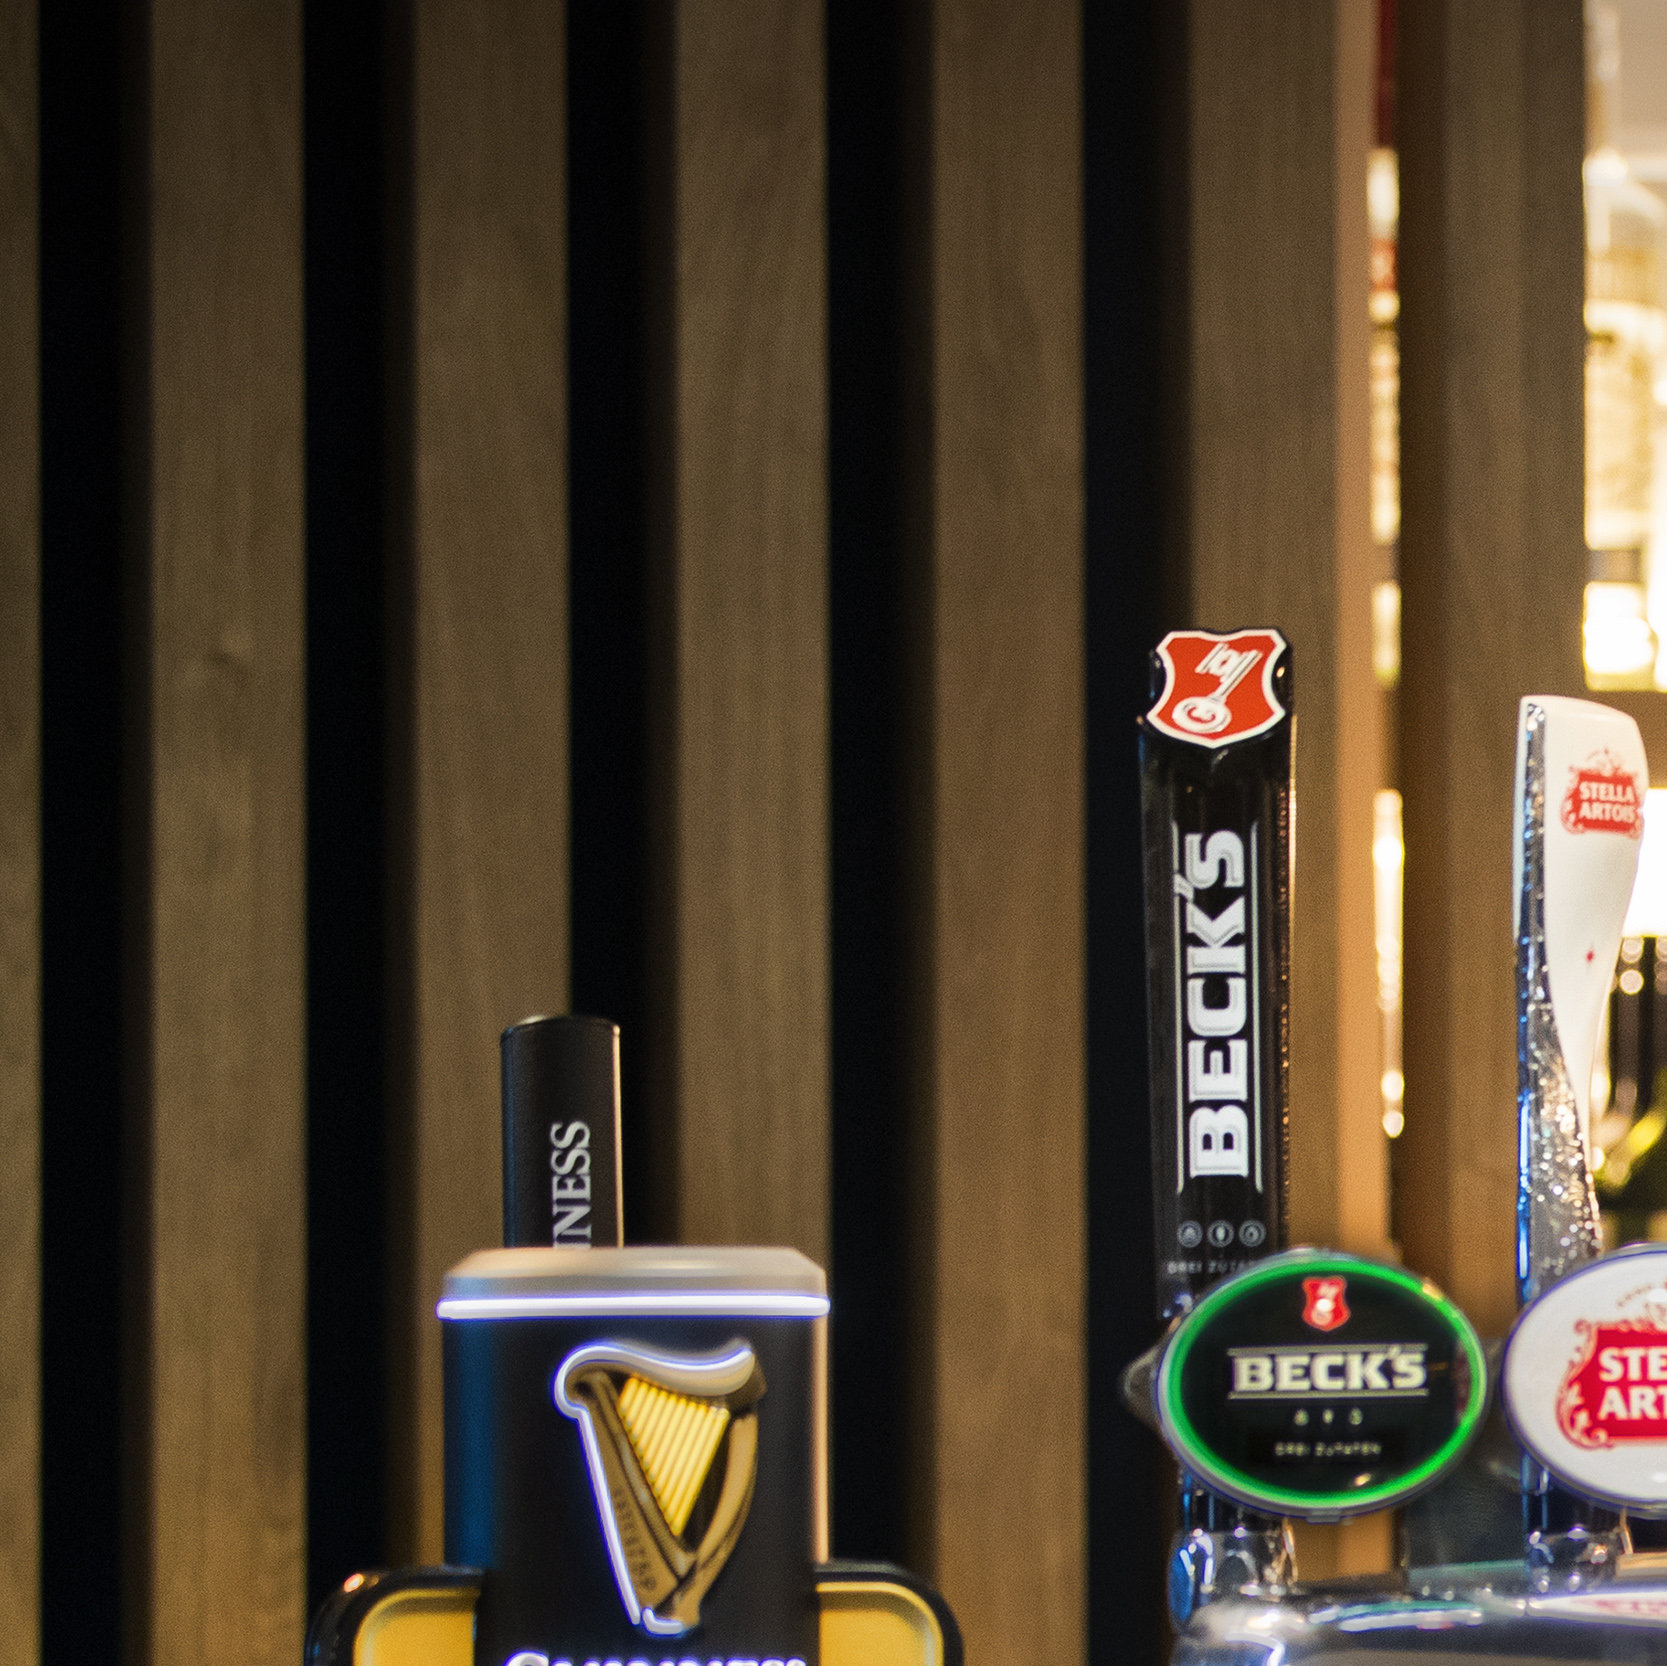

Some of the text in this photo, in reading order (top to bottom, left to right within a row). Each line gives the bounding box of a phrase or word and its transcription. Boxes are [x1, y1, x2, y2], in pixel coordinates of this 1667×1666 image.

[1579, 781, 1635, 802] STELLA
[1579, 801, 1637, 823] ARTOIS
[1174, 830, 1248, 1177] BECK'S
[549, 1121, 592, 1250] NESS
[1232, 1345, 1427, 1391] BECK'S
